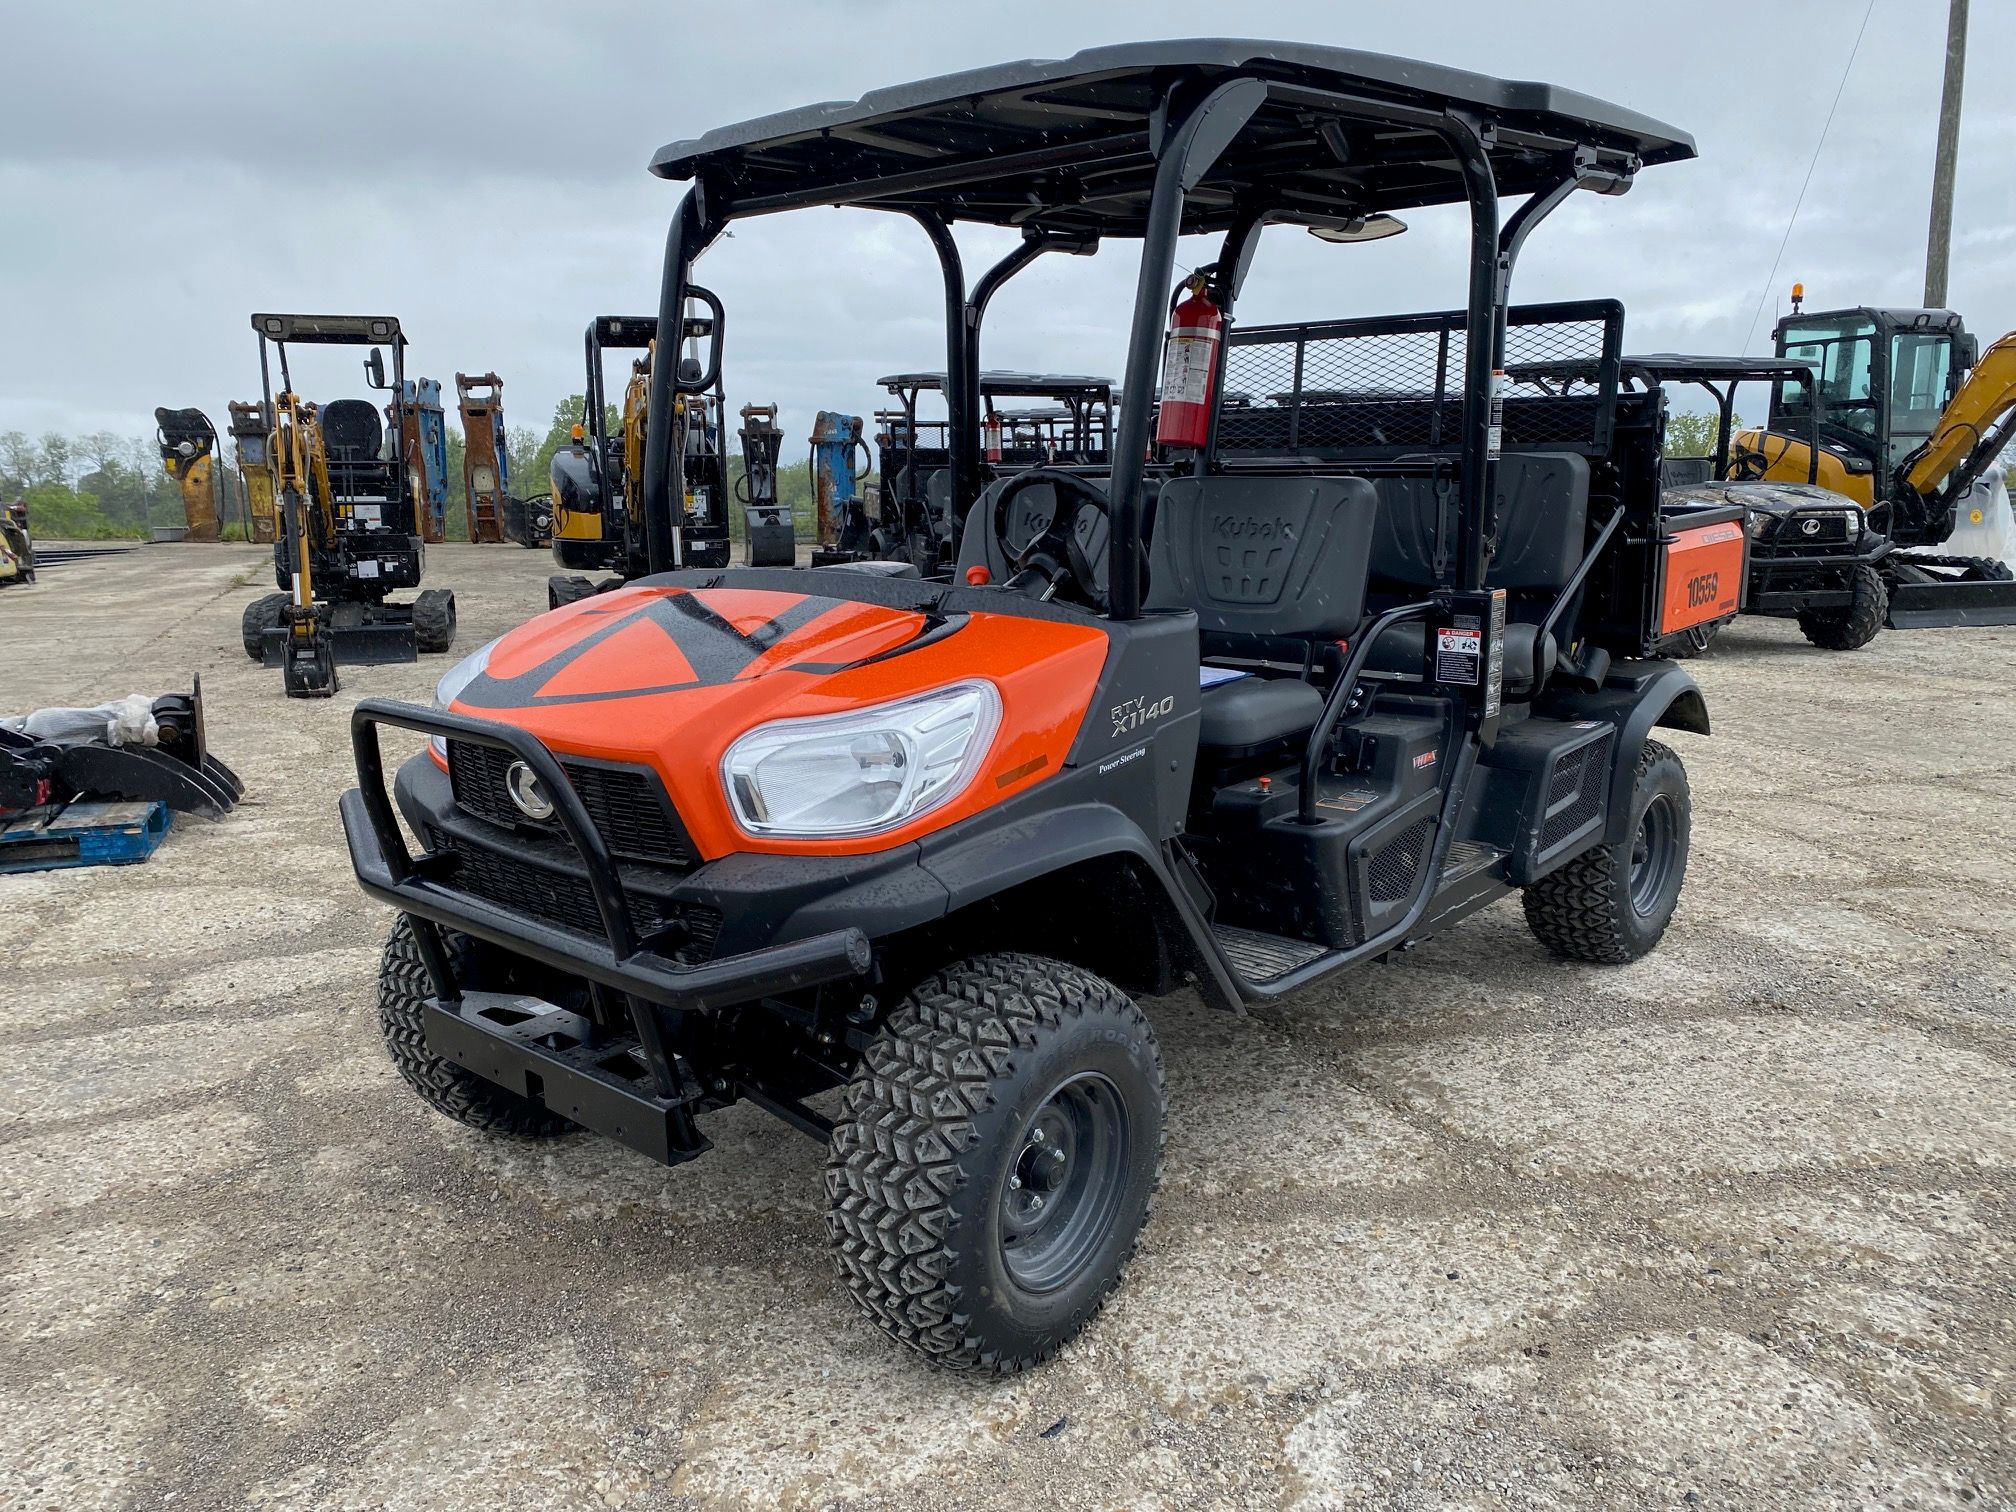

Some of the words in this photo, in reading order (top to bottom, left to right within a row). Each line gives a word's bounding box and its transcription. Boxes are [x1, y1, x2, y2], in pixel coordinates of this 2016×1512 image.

[1212, 515, 1294, 541] Kubota
[1687, 572, 1719, 608] 10559
[1111, 696, 1145, 719] RTV
[1111, 696, 1174, 738] X1140
[1099, 760, 1120, 774] Power
[1120, 748, 1146, 764] Steering
